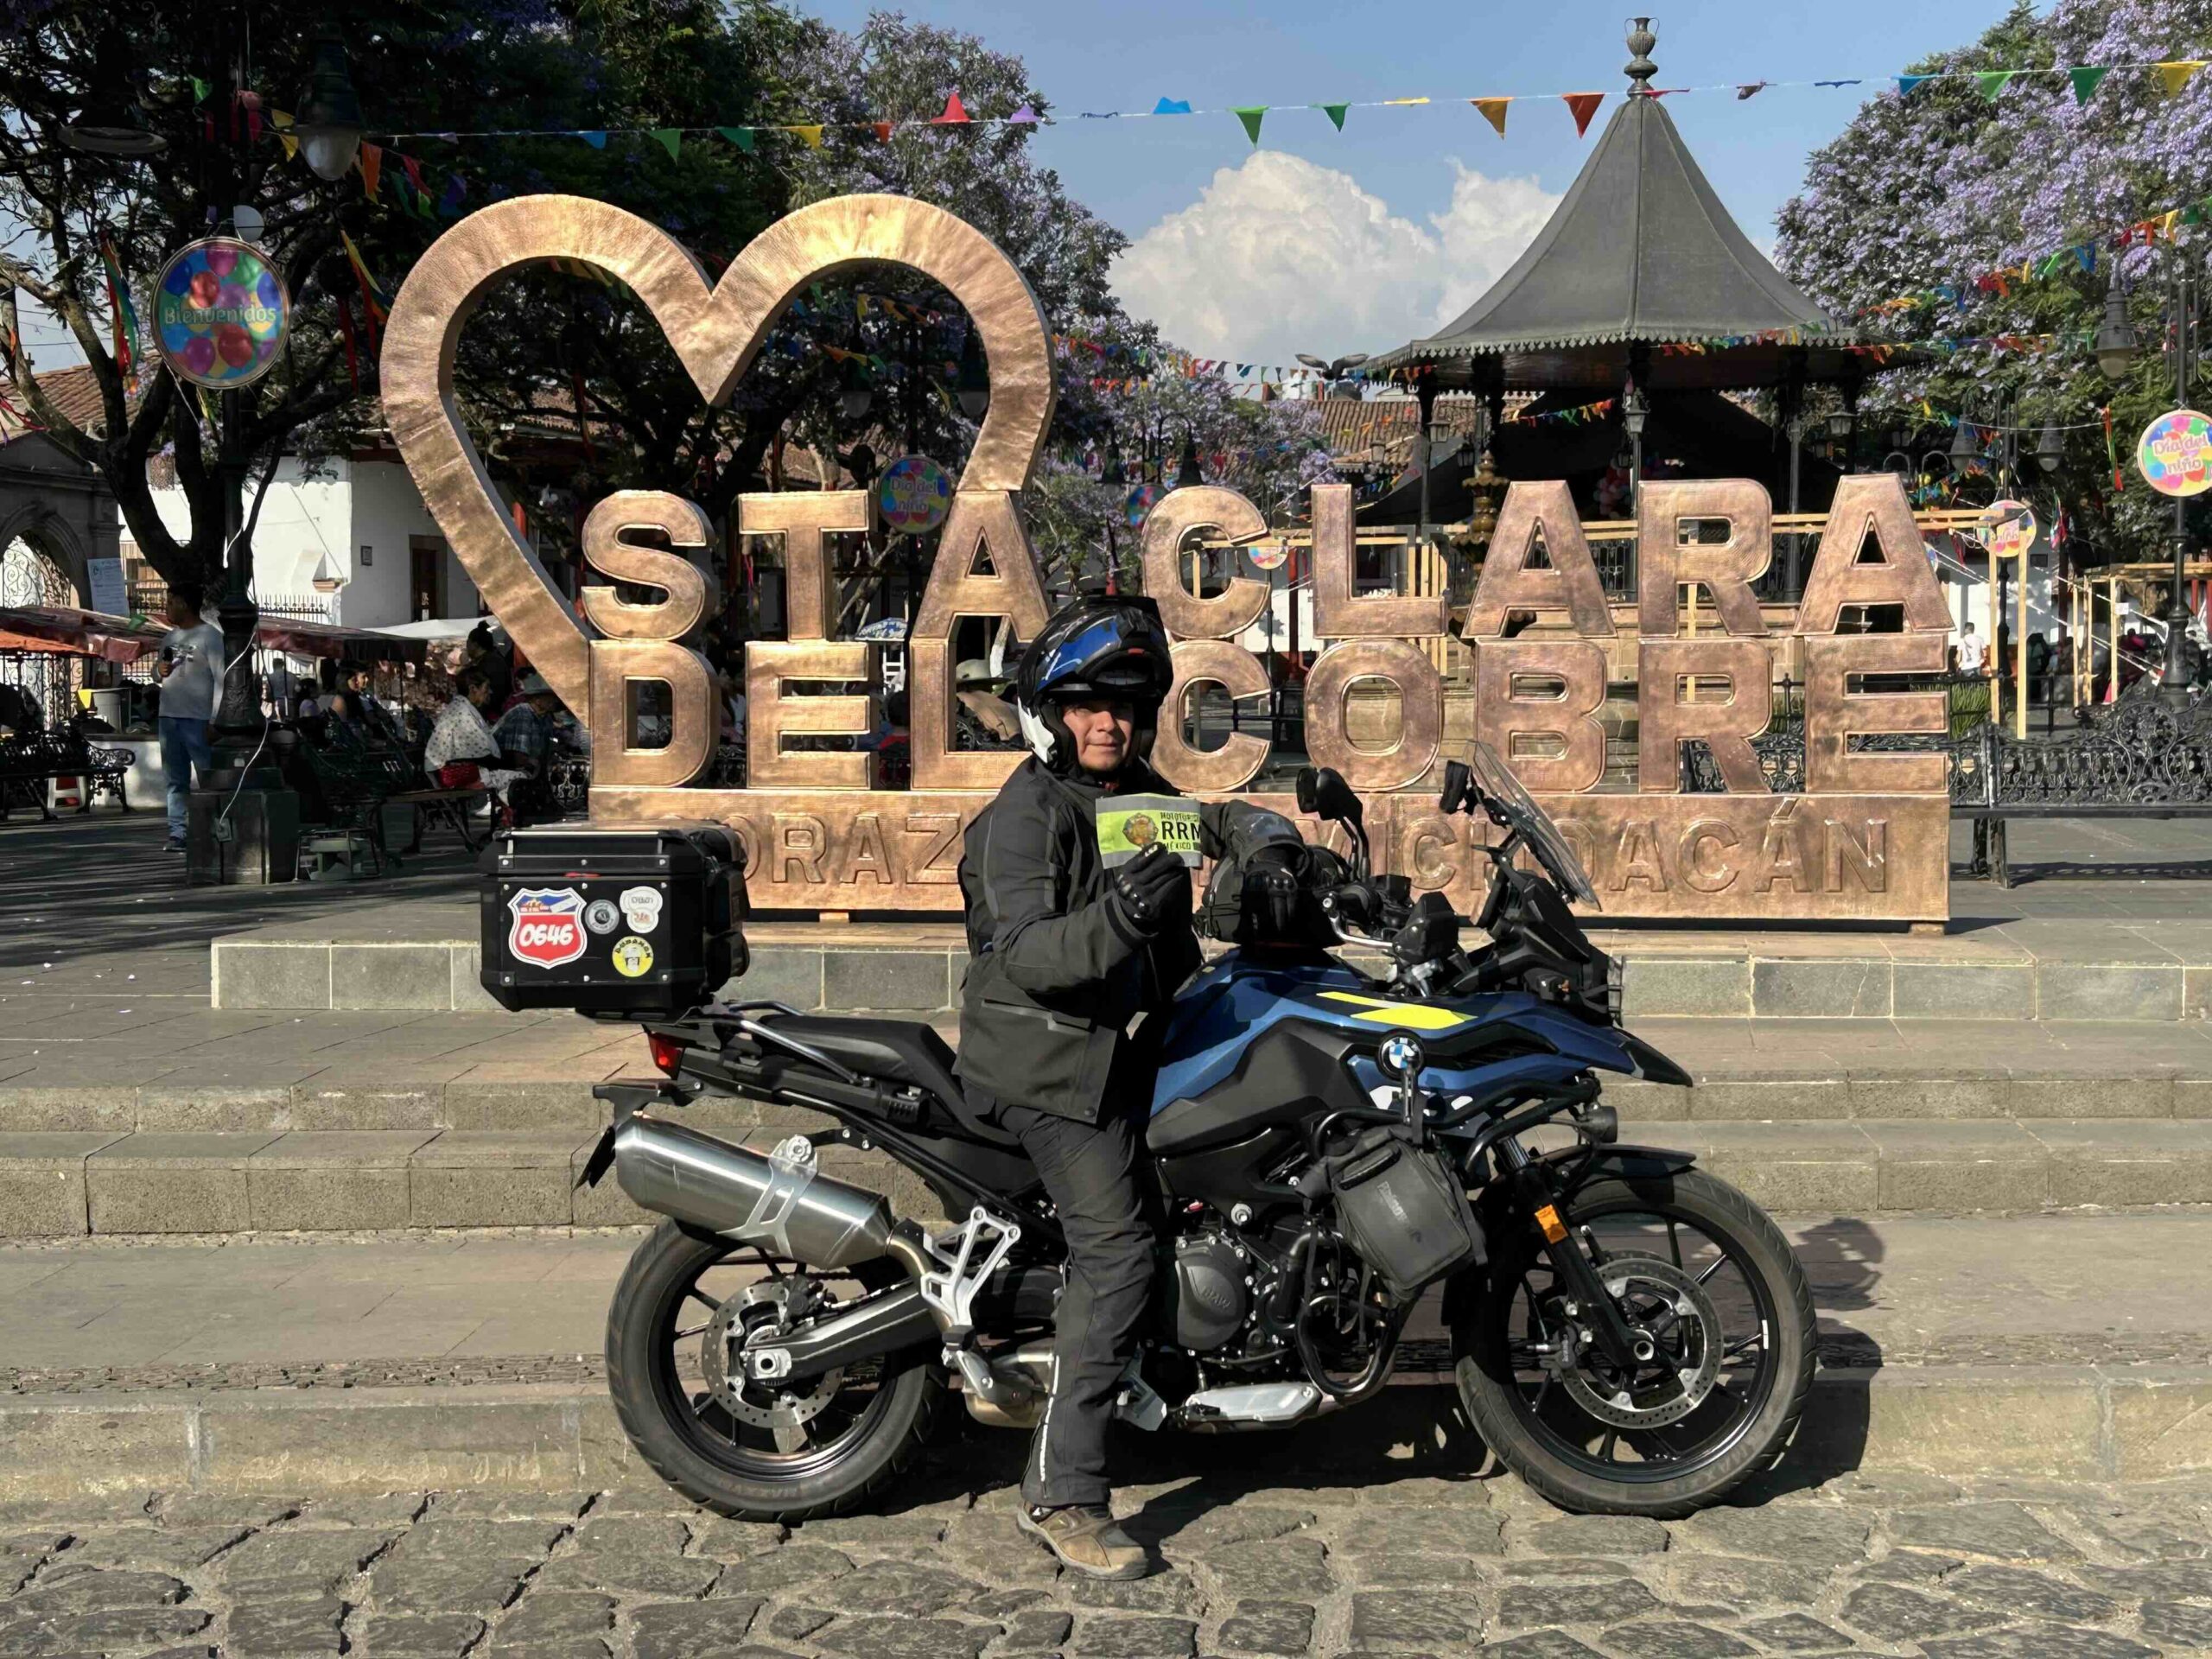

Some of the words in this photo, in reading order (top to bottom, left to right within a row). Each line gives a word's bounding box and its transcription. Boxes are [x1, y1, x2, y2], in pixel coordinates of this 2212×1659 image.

[164, 305, 276, 324] Bienvenidos
[581, 489, 1049, 641] STA
[1142, 473, 1956, 639] CLARA
[589, 639, 1034, 791] DEL
[1152, 633, 1949, 794] COBRE
[519, 923, 574, 947] 0646
